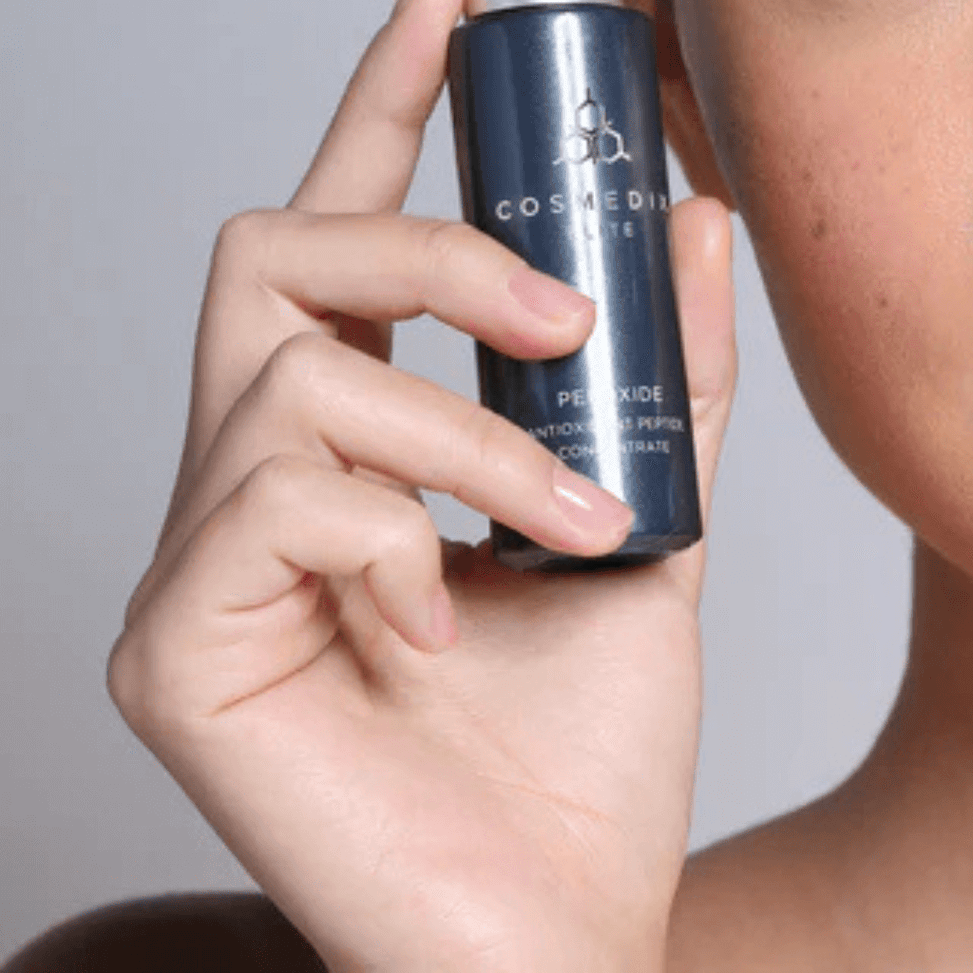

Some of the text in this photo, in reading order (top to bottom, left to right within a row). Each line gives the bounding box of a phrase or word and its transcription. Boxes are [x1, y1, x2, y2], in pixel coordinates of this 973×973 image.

[566, 221, 634, 240] LTE
[557, 385, 664, 408] PEXIDE
[528, 416, 633, 439] ANTIOXT
[558, 440, 670, 460] CONTRATE
